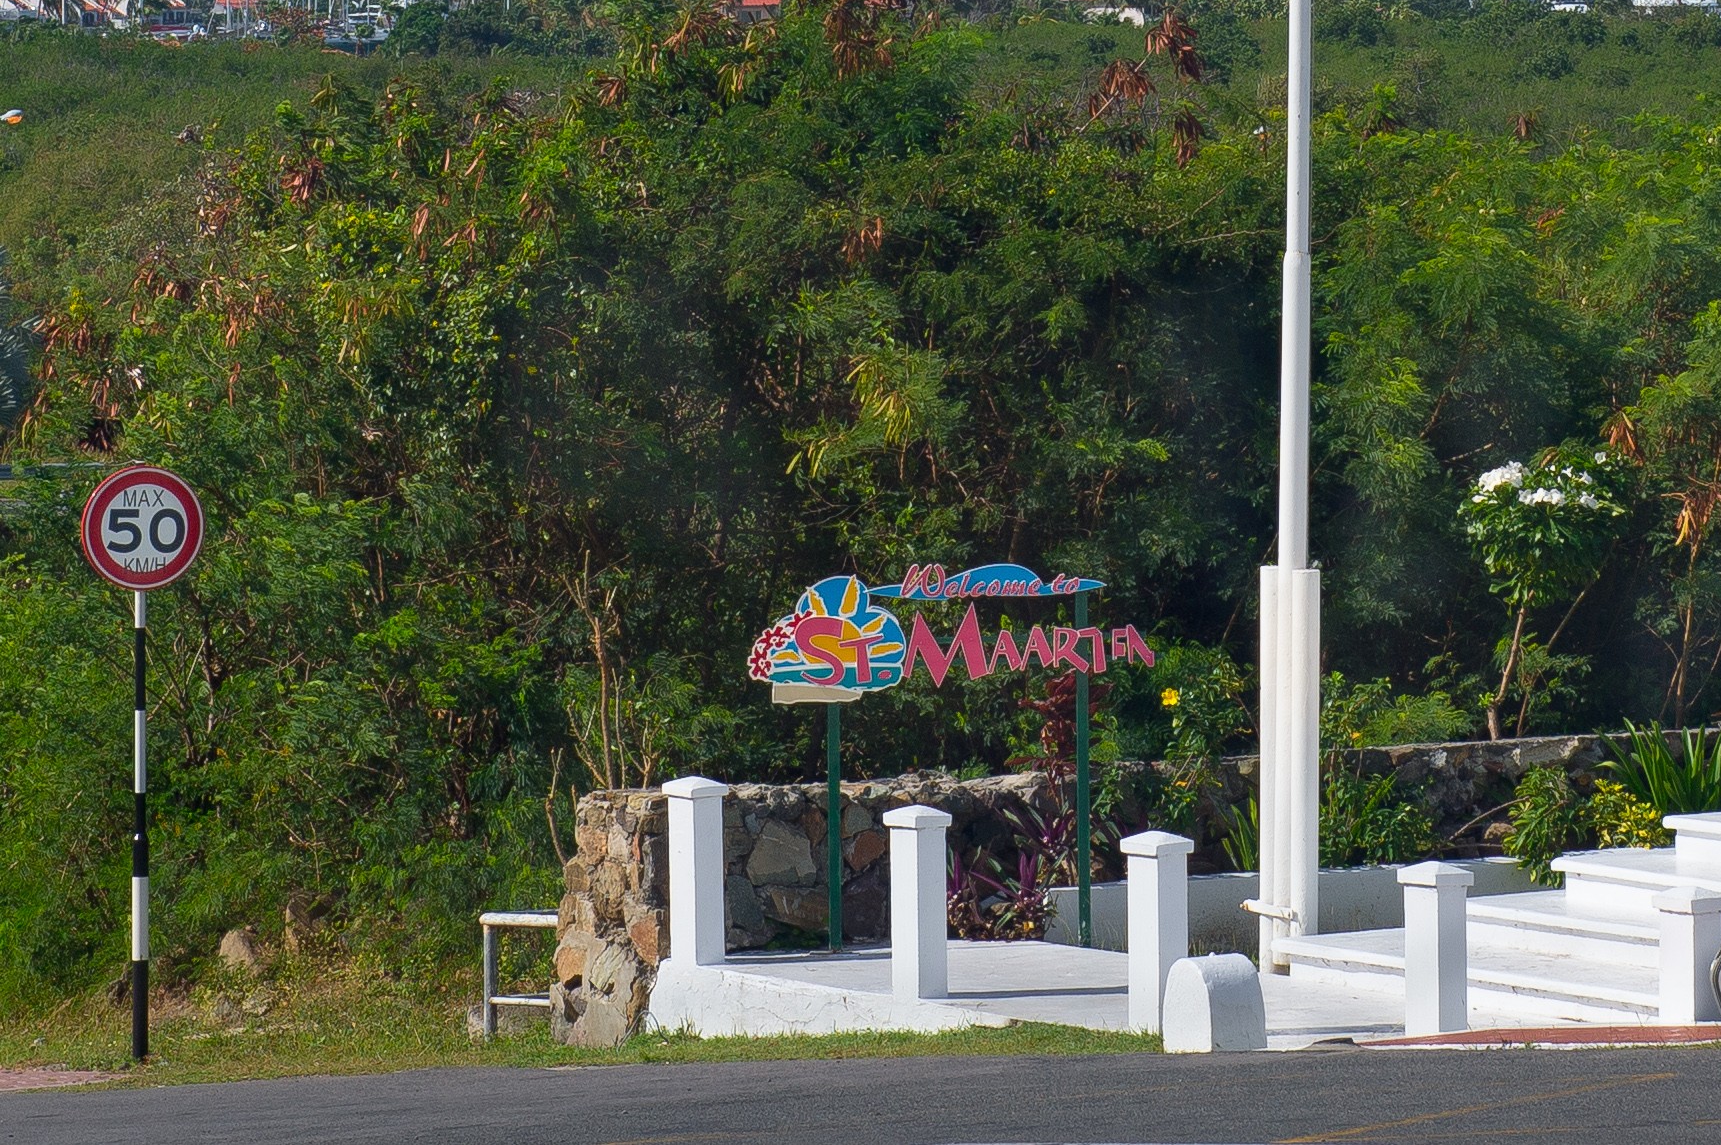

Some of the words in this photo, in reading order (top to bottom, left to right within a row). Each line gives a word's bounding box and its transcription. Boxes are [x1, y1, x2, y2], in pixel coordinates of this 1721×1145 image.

[123, 489, 165, 507] MAX
[106, 508, 186, 554] 50
[124, 556, 167, 573] KM/H
[900, 562, 1041, 598] Welcome
[1051, 572, 1081, 595] to
[795, 616, 893, 687] ST.
[902, 601, 1155, 688] MAARTEN
